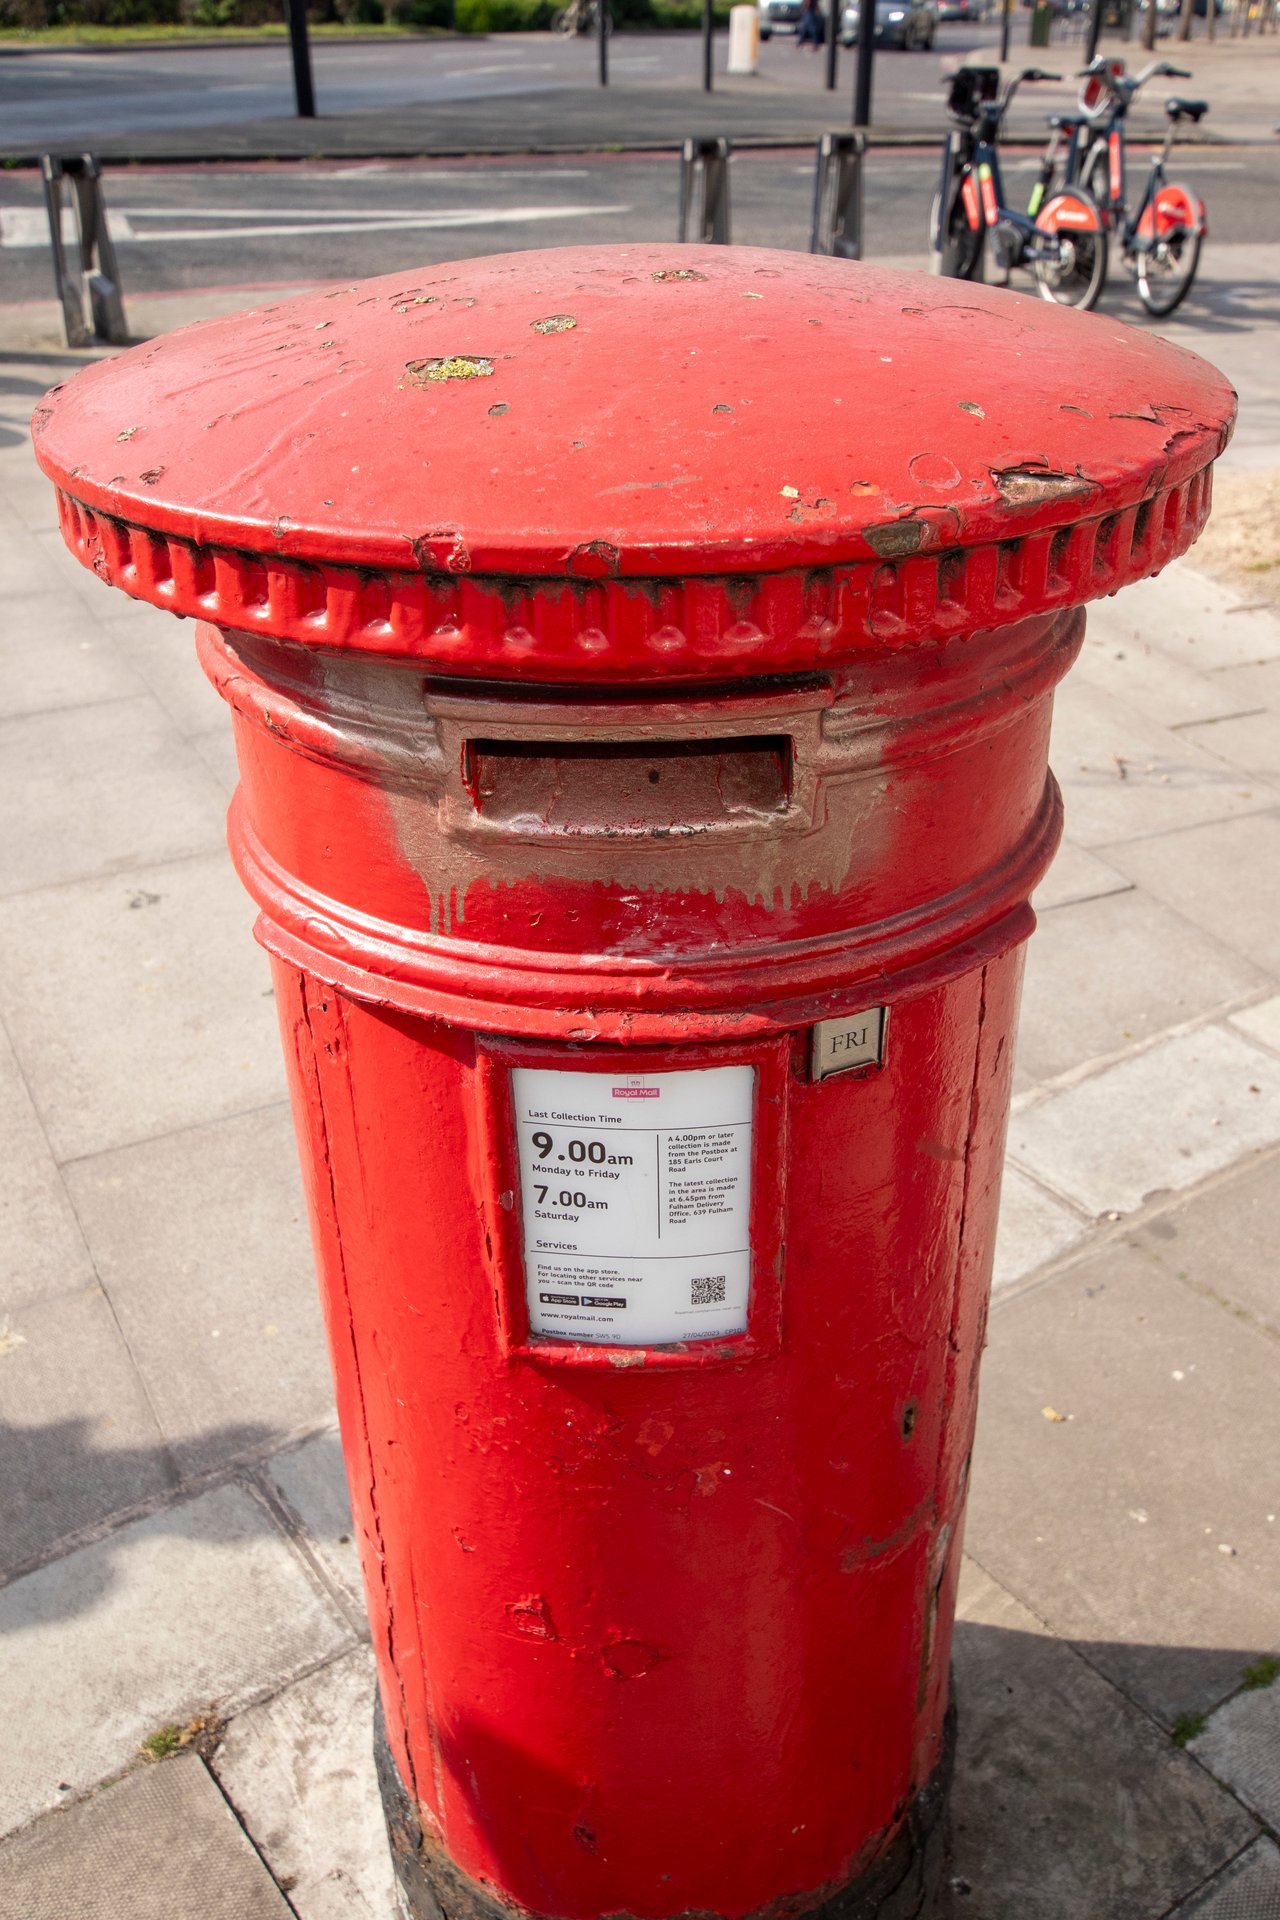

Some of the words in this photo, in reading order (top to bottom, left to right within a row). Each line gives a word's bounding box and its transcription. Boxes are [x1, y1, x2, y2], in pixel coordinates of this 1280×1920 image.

[830, 1028, 868, 1054] FRI
[528, 1110, 548, 1118] Last
[551, 1112, 596, 1122] Collection
[599, 1115, 622, 1123] Time
[532, 1132, 633, 1165] 9.00am
[532, 1164, 571, 1176] Monday
[575, 1168, 584, 1176] to
[589, 1170, 620, 1180] Friday
[706, 1177, 738, 1185] collection
[533, 1184, 608, 1209] 7.00am
[535, 1210, 579, 1222] Saturday
[537, 1240, 577, 1250] Services
[540, 1312, 613, 1322] www.royalmail.com
[682, 1330, 720, 1339] 27/04/2023
